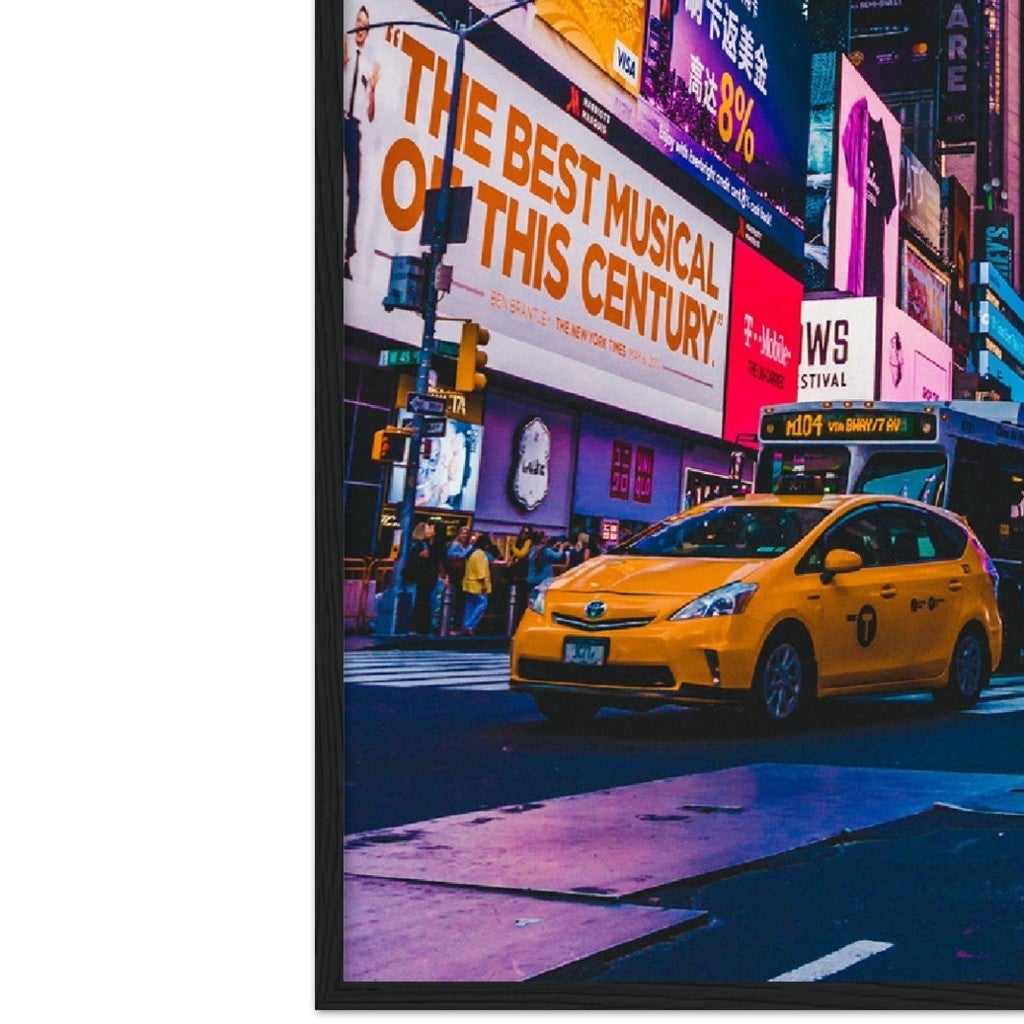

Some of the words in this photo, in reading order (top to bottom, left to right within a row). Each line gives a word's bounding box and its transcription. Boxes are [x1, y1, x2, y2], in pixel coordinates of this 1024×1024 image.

[617, 46, 636, 79] VISA
[502, 104, 601, 226] BEST
[604, 173, 720, 301] MUSICAL
[477, 180, 571, 301] THIS
[556, 317, 570, 336] THE
[571, 324, 587, 342] NEW
[589, 330, 607, 350] YORK
[609, 338, 626, 358] TIMES
[799, 319, 849, 366] WS
[785, 413, 824, 437] M104
